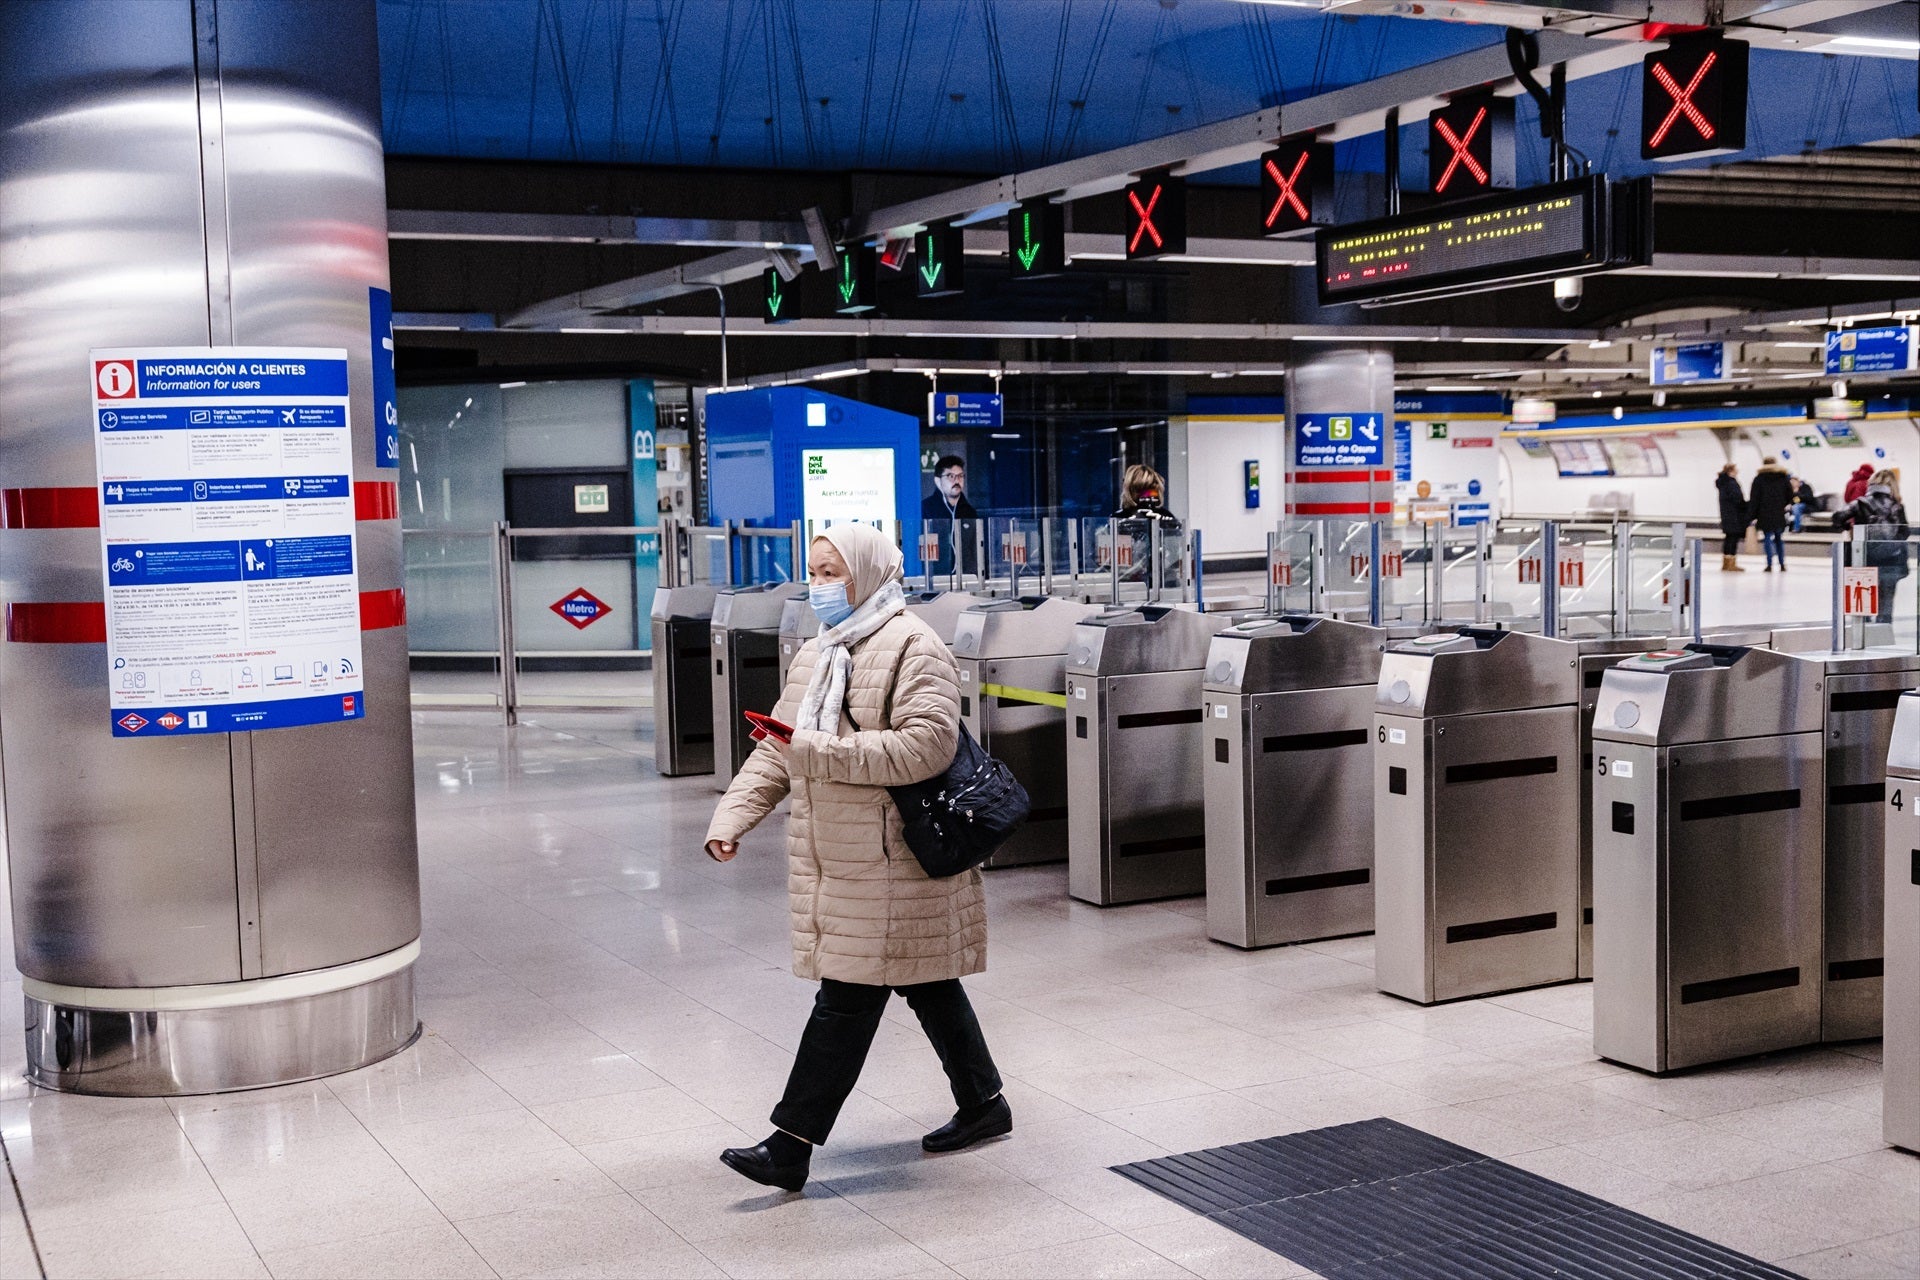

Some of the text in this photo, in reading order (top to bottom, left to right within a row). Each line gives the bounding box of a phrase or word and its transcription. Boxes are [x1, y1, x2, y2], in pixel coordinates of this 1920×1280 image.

[146, 362, 306, 376] INFORMACIÓN A CLIENTES
[146, 379, 261, 391] Information for users
[1334, 420, 1347, 437] 5
[1302, 444, 1376, 454] Alameda de Osuna
[1301, 455, 1366, 465] Casa de Campo
[566, 602, 594, 614] Metro
[1068, 680, 1074, 696] 8
[1205, 702, 1211, 719] 7
[194, 714, 200, 726] 1
[1378, 725, 1386, 744] 6
[1598, 755, 1607, 776] 5
[1891, 788, 1903, 811] 4
